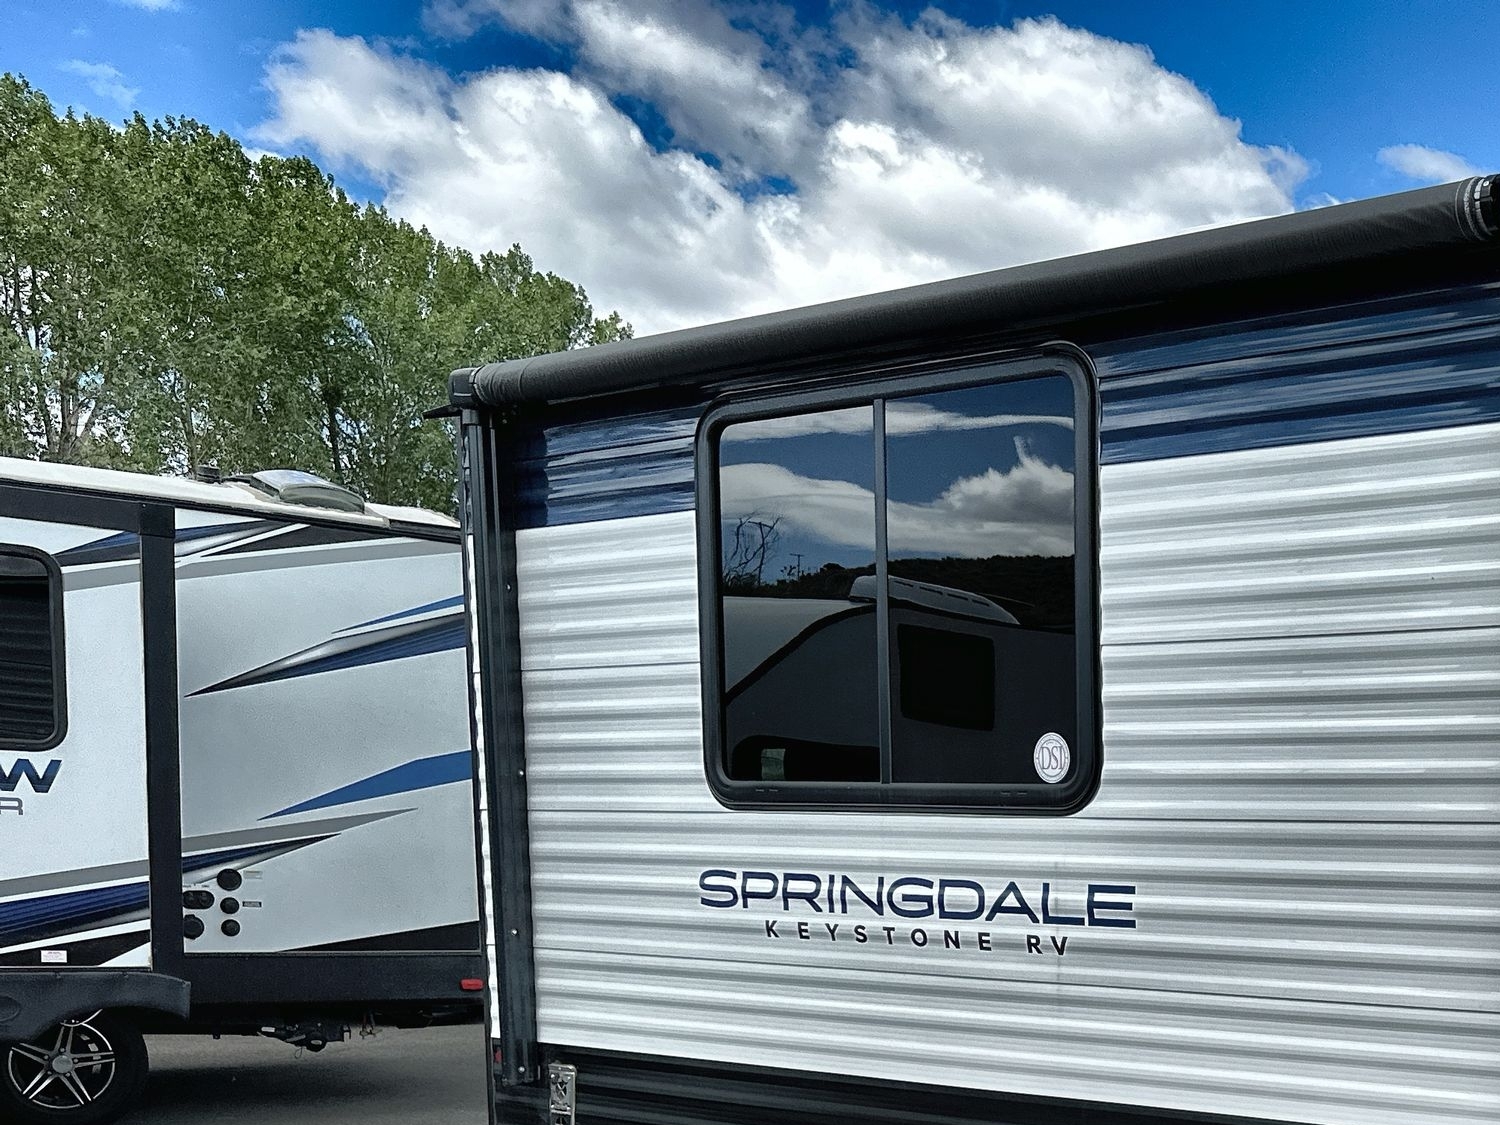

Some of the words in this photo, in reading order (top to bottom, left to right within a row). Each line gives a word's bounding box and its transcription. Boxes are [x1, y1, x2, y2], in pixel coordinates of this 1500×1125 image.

[1040, 745, 1064, 770] DSI
[699, 868, 1137, 929] SPRINGDALE
[766, 919, 993, 952] KEYSTONE
[1026, 934, 1069, 957] RV
